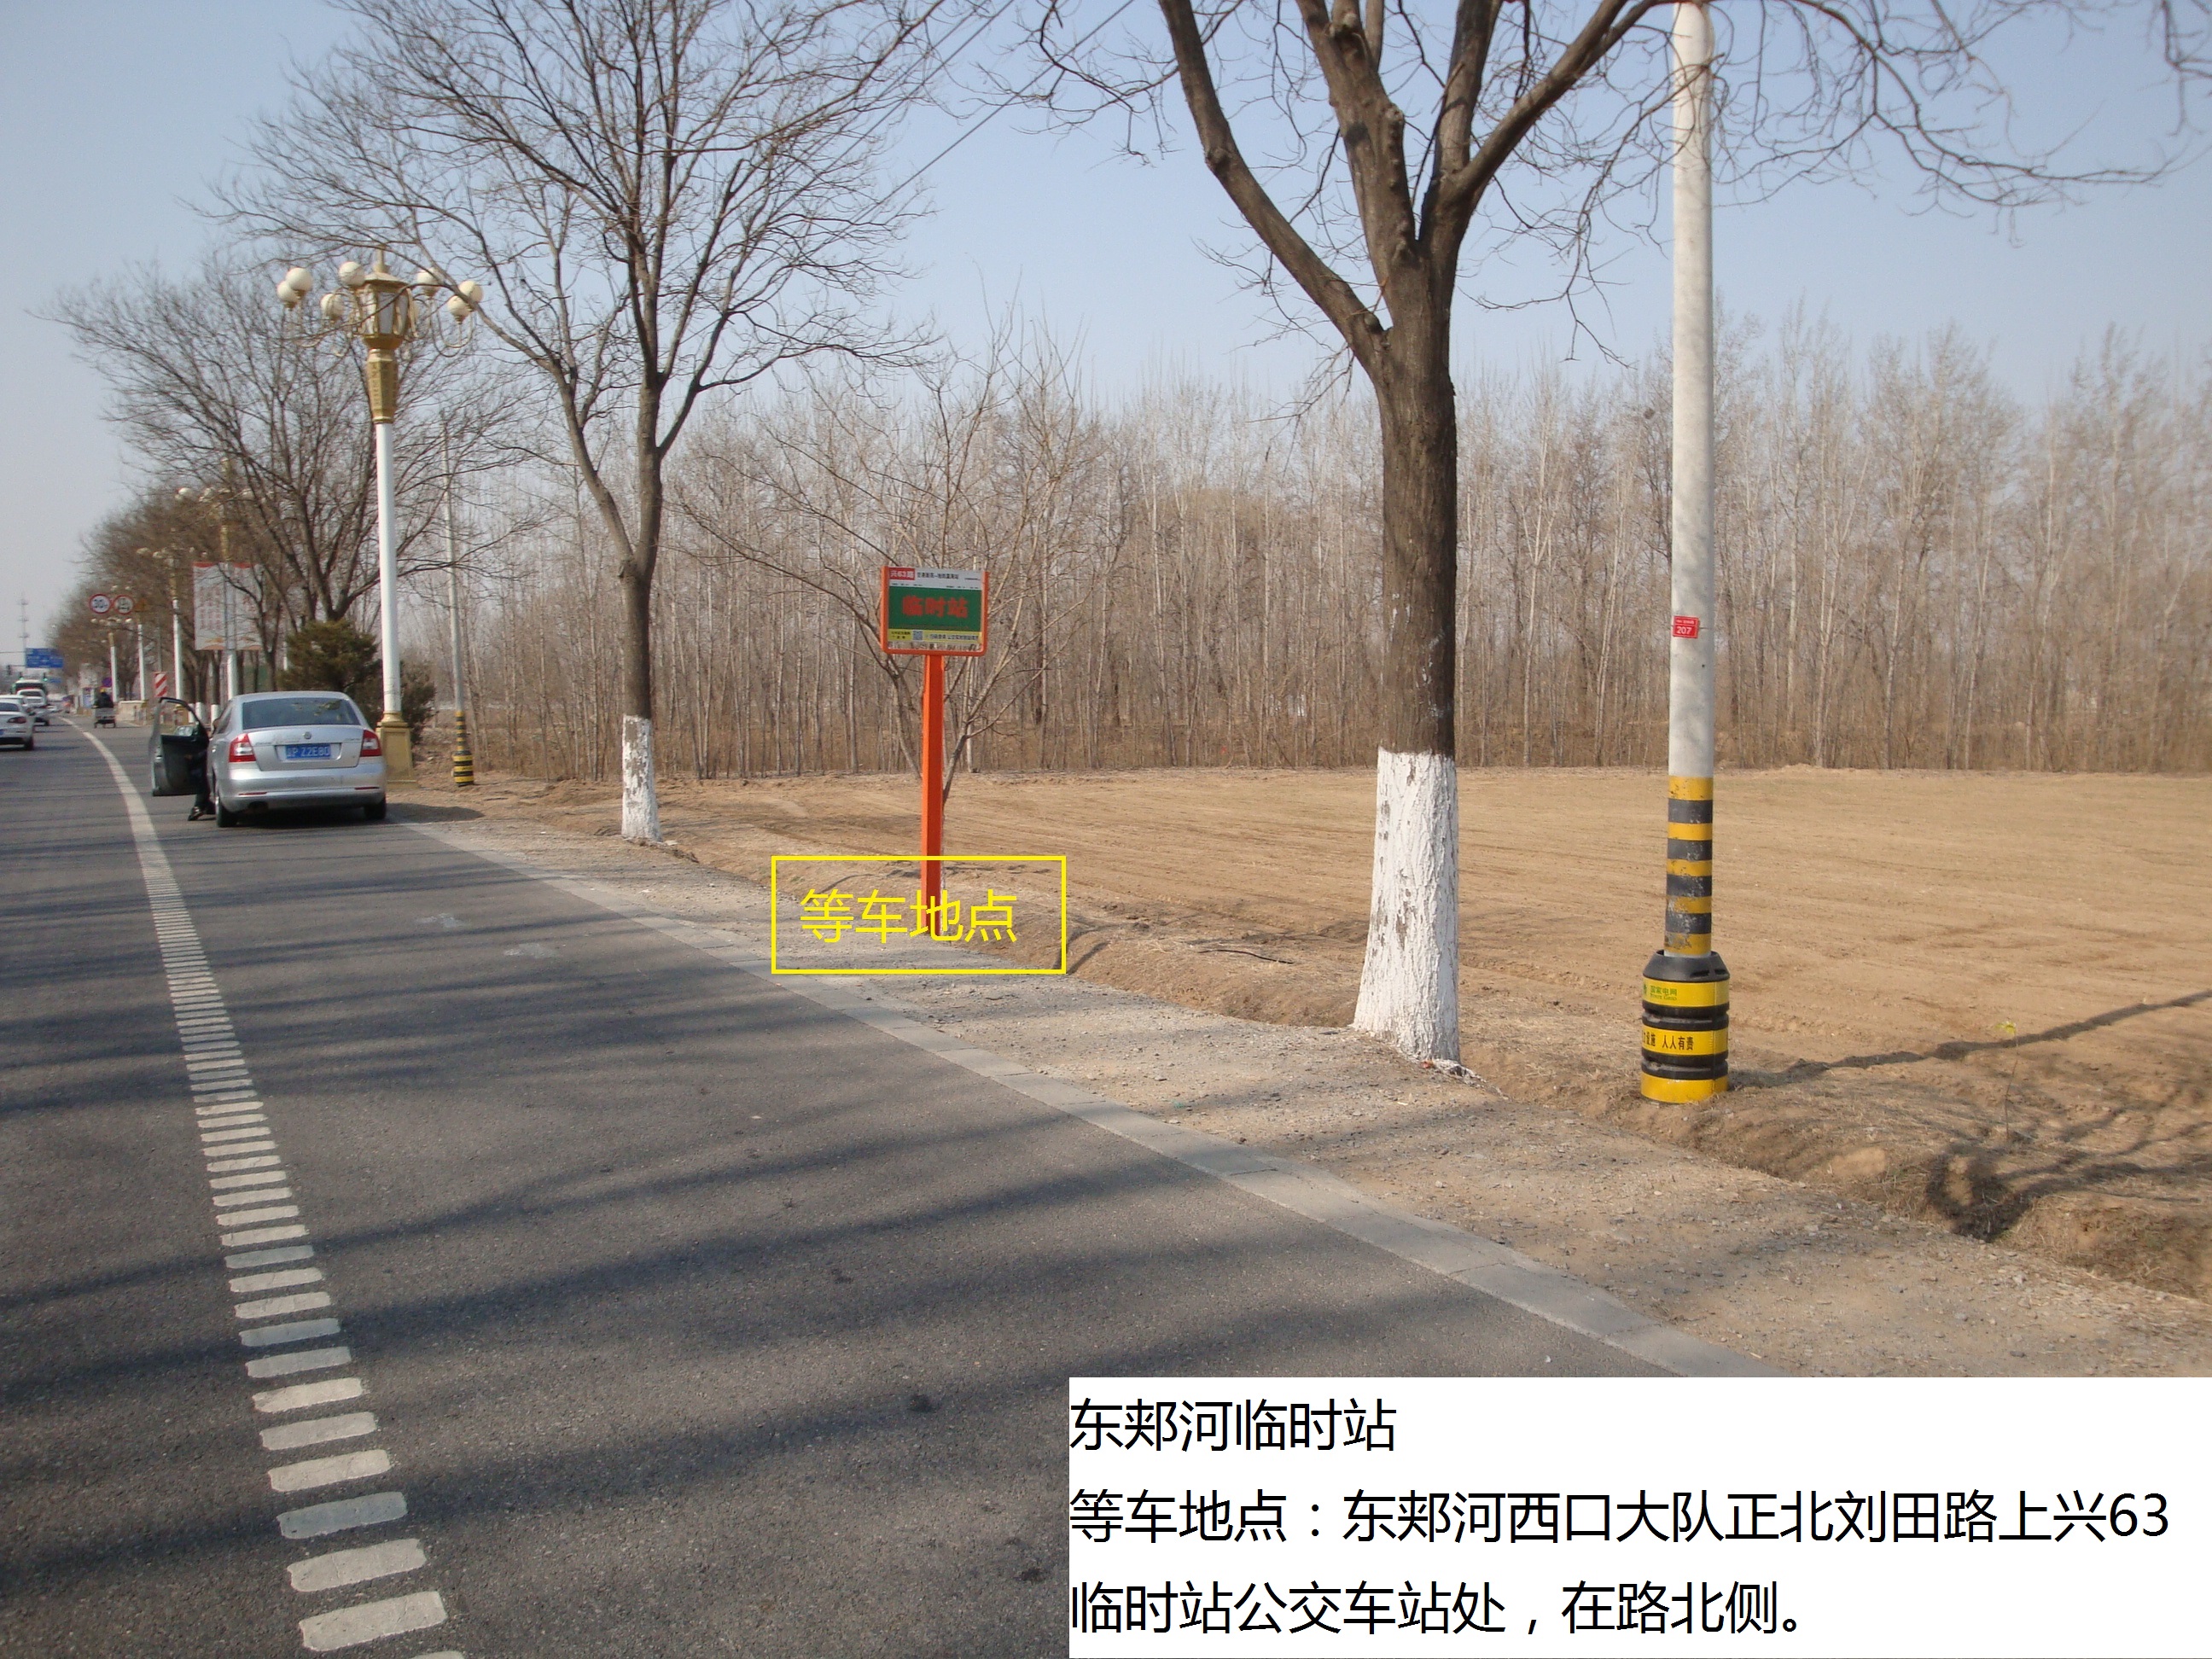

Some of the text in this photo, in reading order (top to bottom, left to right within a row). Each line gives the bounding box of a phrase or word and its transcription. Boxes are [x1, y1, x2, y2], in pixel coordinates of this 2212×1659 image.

[902, 595, 968, 618] 临时站
[1676, 626, 1692, 635] 207
[1650, 985, 1678, 997] 国家电网
[1662, 1034, 1694, 1051] 人人有责
